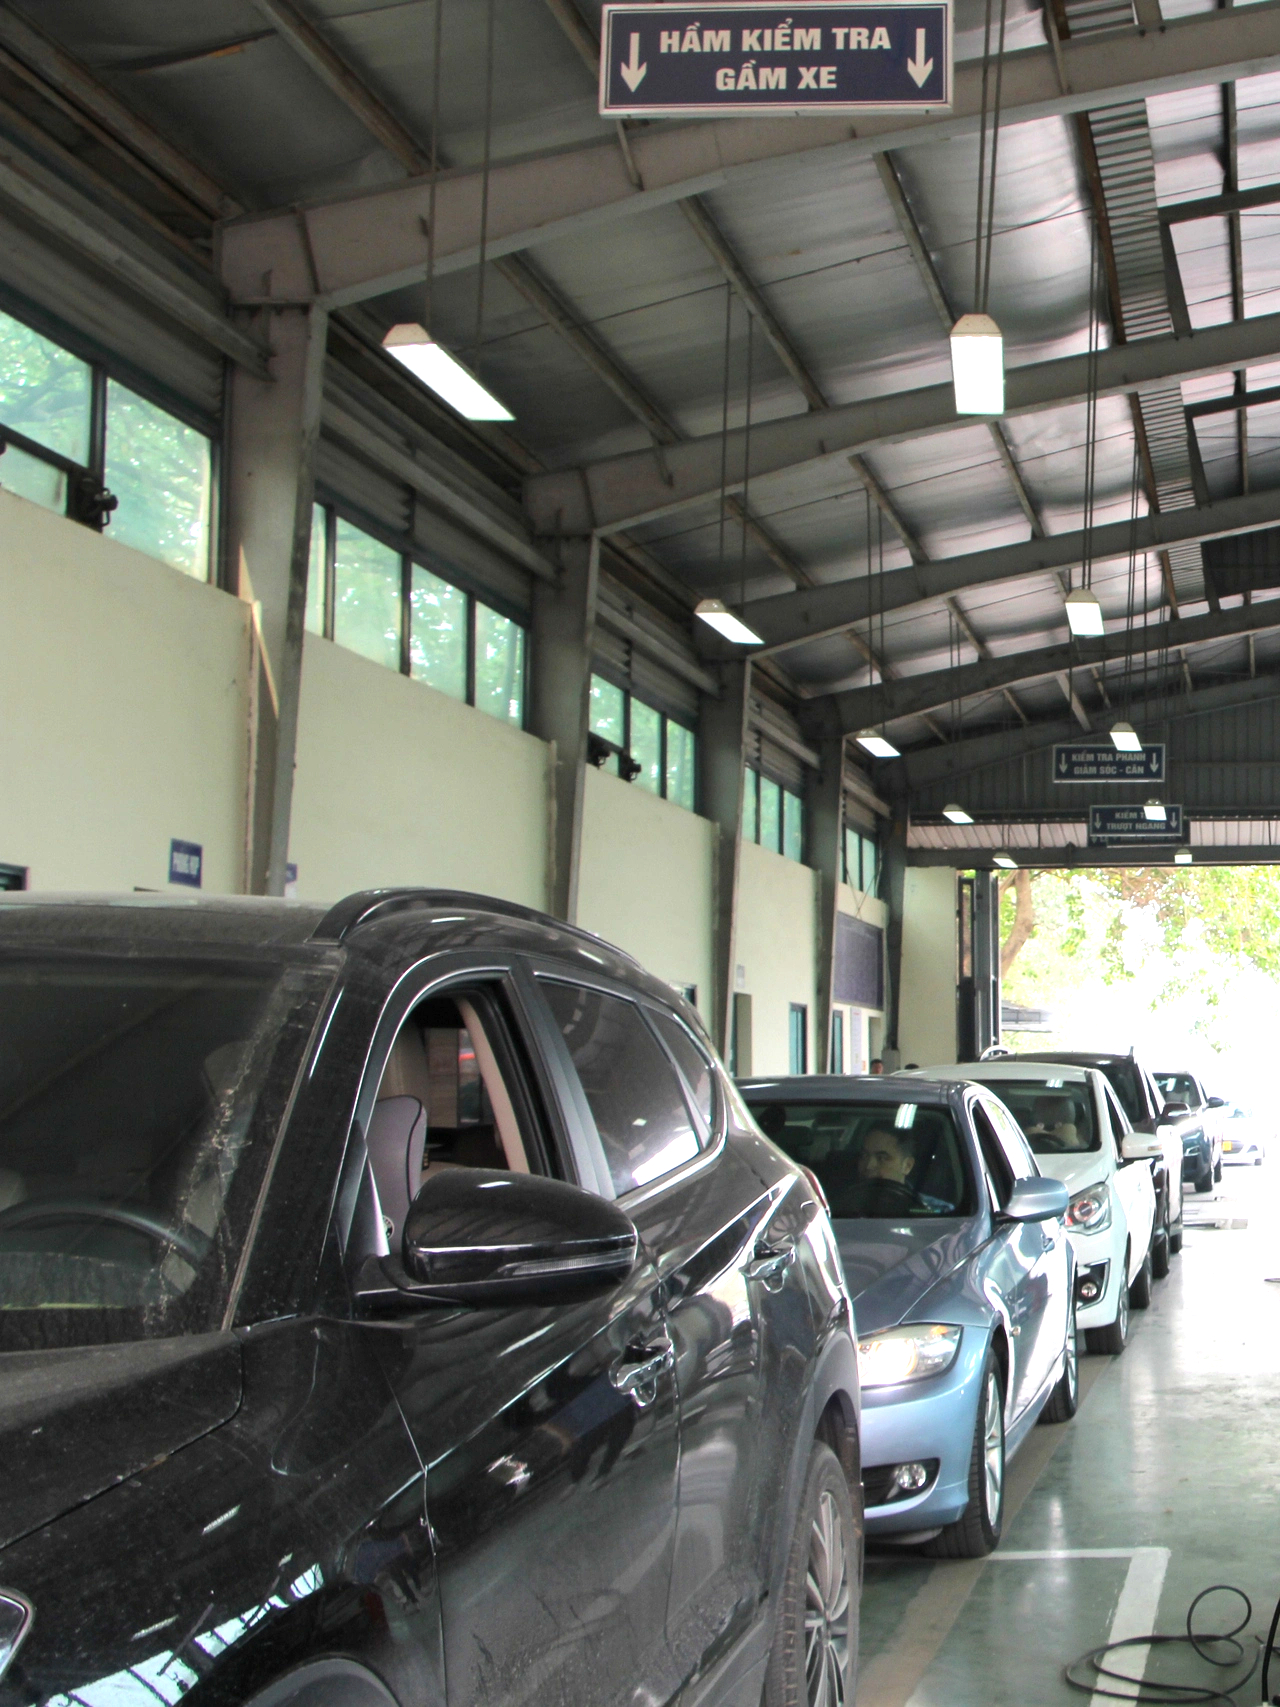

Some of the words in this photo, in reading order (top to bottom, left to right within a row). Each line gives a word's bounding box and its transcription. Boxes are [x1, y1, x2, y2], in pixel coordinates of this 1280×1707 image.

[660, 22, 731, 53] HẦM
[742, 18, 822, 52] KIỂM
[832, 27, 892, 50] TRA
[715, 59, 788, 91] GẦM
[797, 66, 837, 90] XE
[1072, 750, 1094, 761] KIỂM
[1097, 753, 1113, 761] TRA
[1116, 753, 1146, 761] PHANH
[1135, 822, 1166, 830] NGANG
